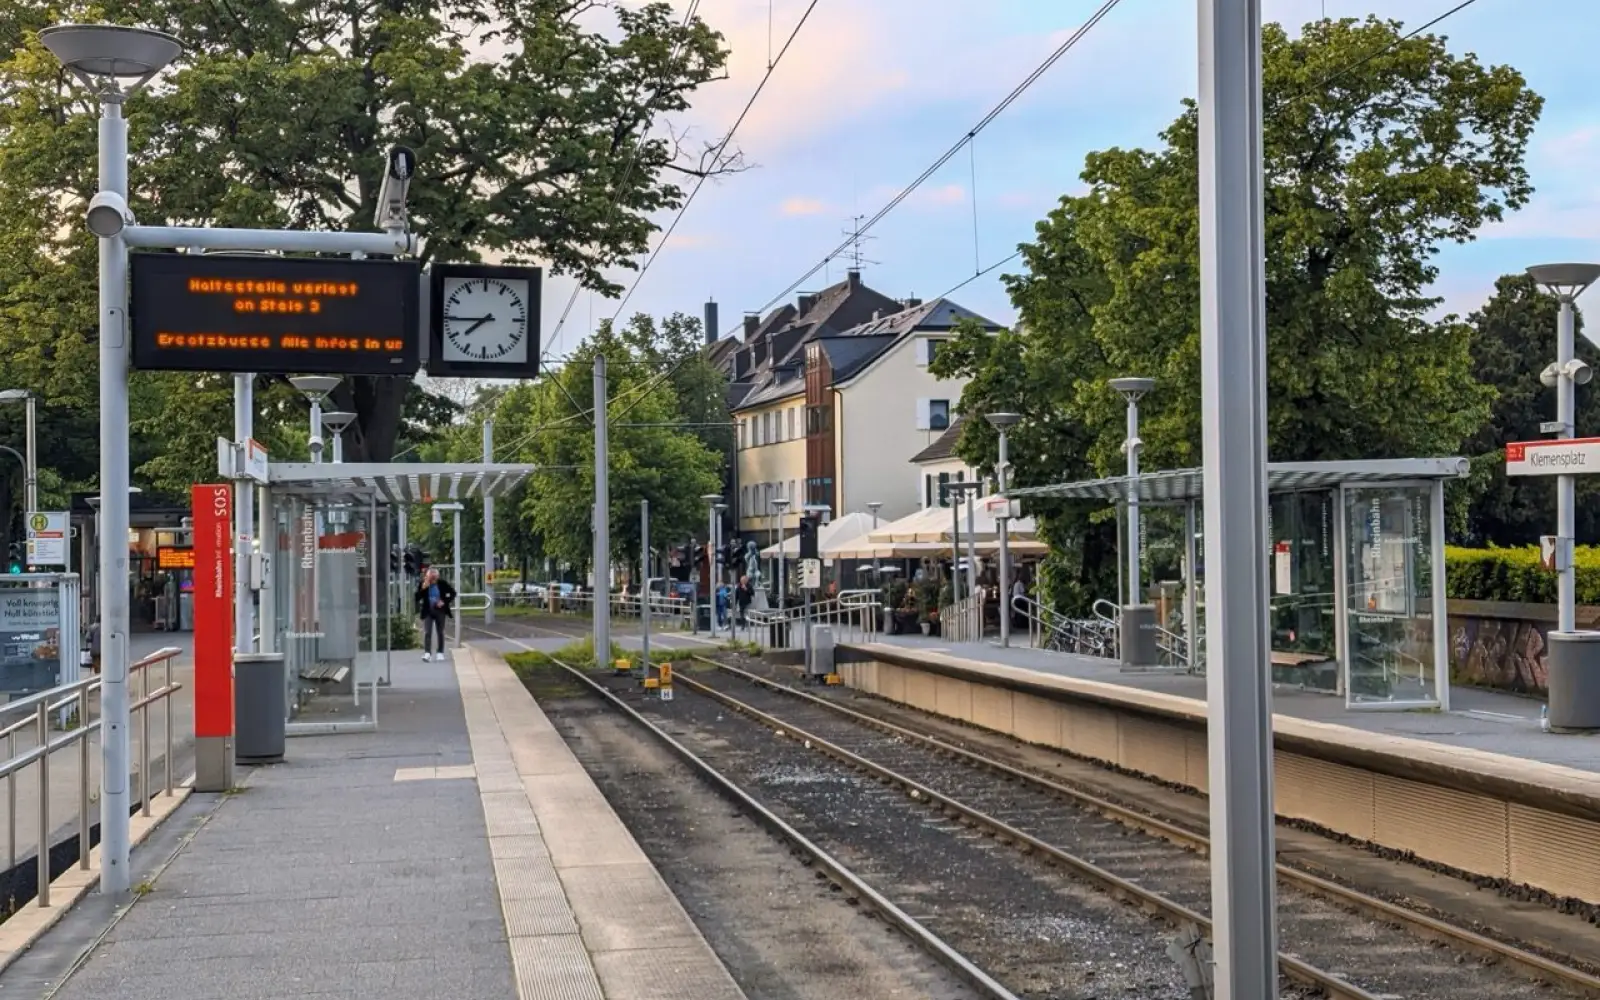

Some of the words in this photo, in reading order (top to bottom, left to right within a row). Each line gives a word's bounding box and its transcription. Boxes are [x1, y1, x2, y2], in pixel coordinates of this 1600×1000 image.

[1530, 451, 1586, 467] Klemensplatz
[214, 488, 226, 516] SOS
[215, 521, 223, 558] Infrmation
[301, 504, 313, 568] Rheinbahn
[1369, 498, 1380, 558] Rheinbahn
[215, 559, 223, 598] Rheinbahn
